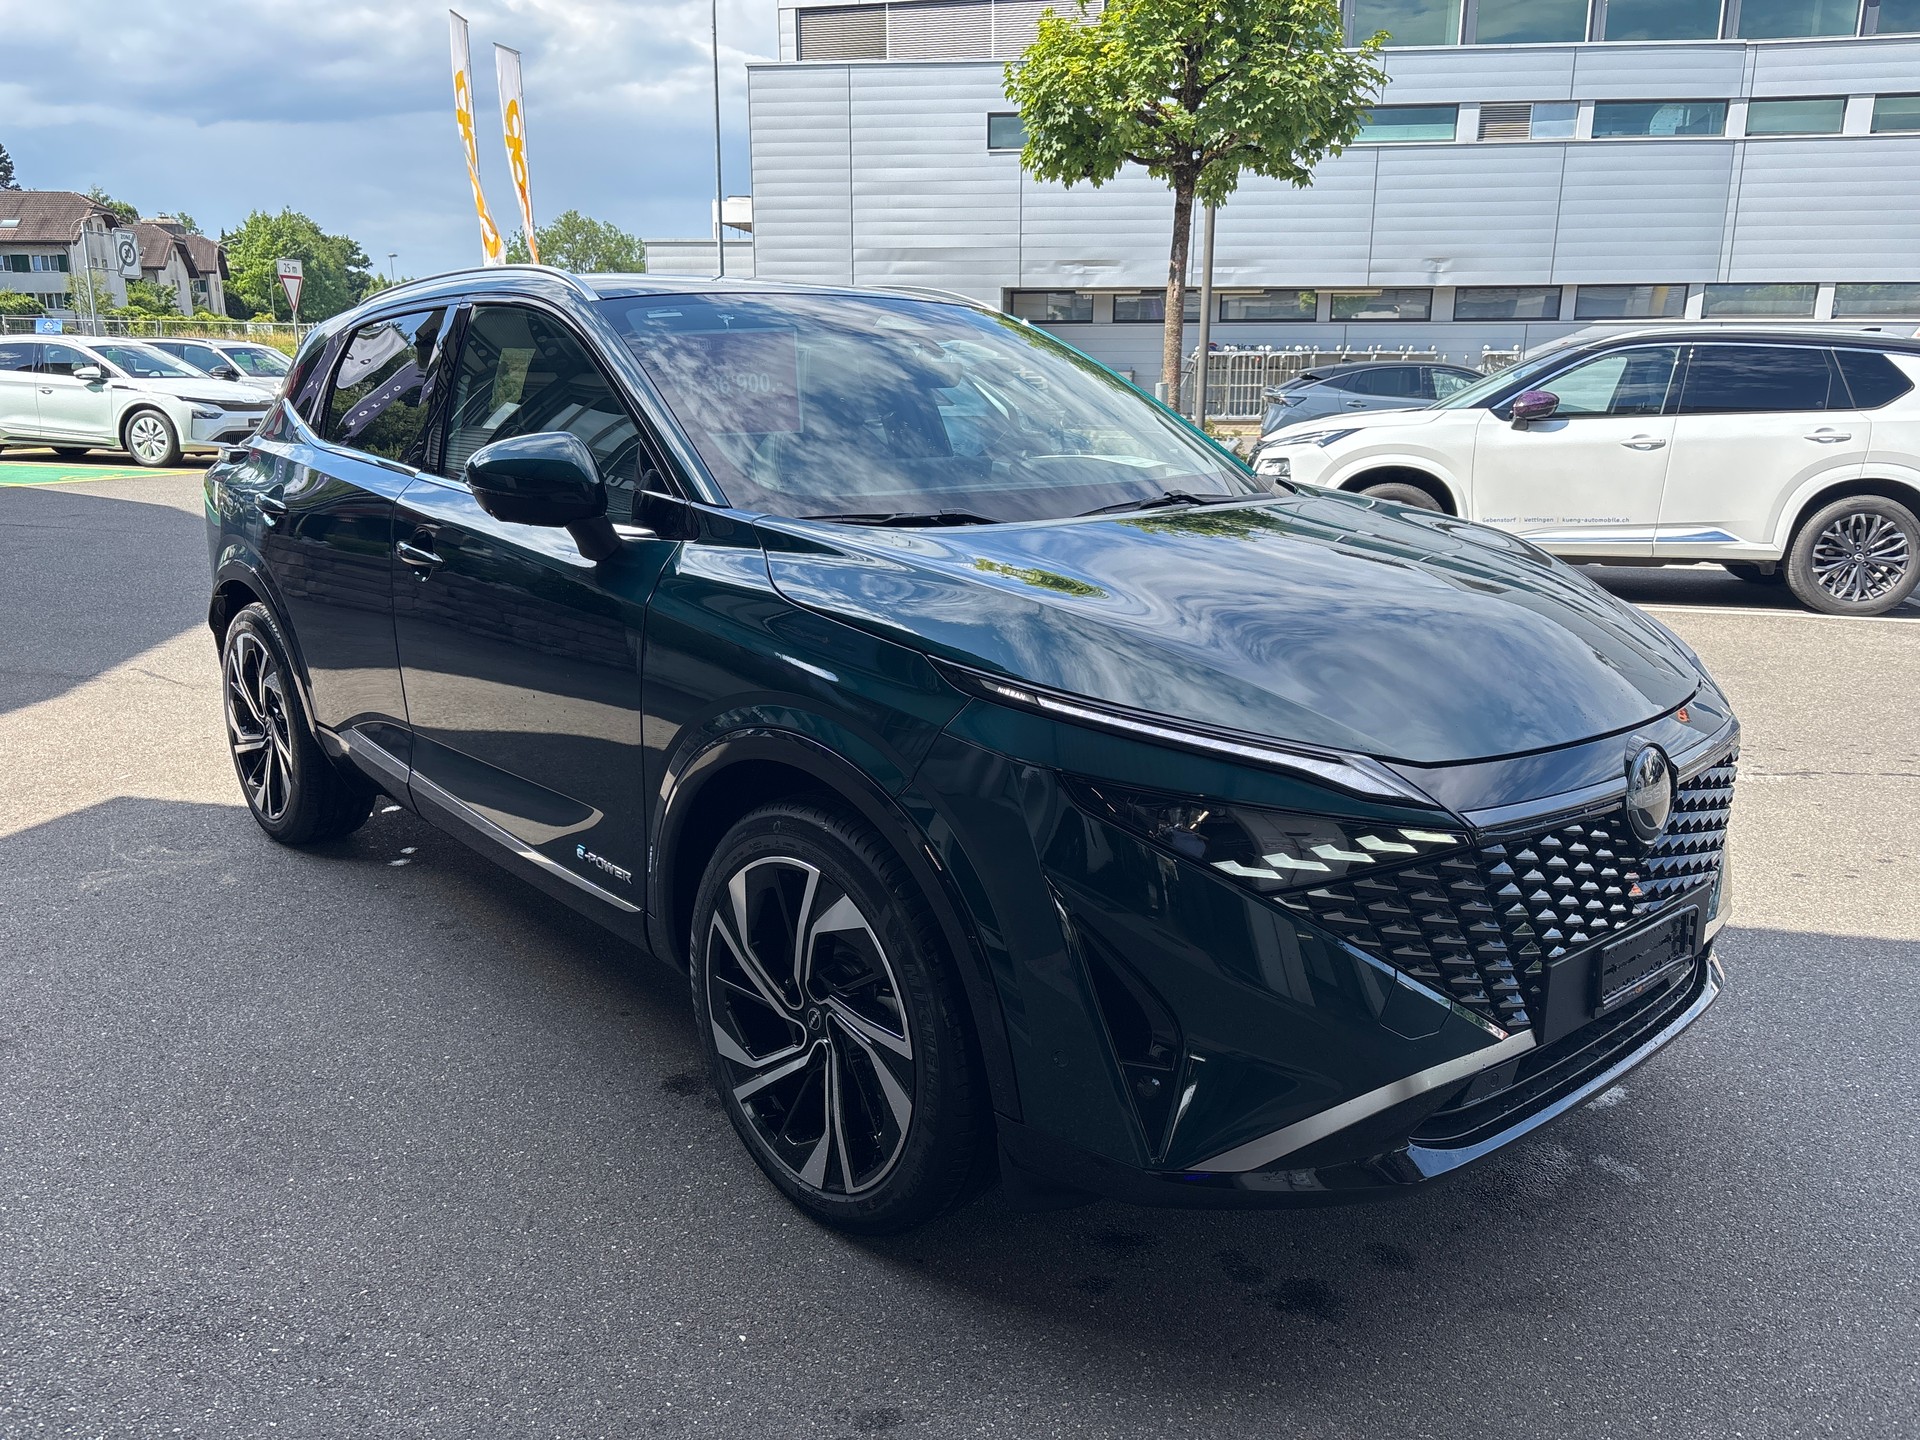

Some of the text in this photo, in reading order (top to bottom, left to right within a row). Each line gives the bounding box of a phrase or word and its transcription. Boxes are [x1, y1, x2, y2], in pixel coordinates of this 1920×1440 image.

[283, 262, 298, 274] 25 m
[348, 385, 402, 426] VOLVO
[997, 686, 1026, 700] NISSAN
[1628, 785, 1669, 807] NISSA
[903, 962, 939, 1122] MICHELIN
